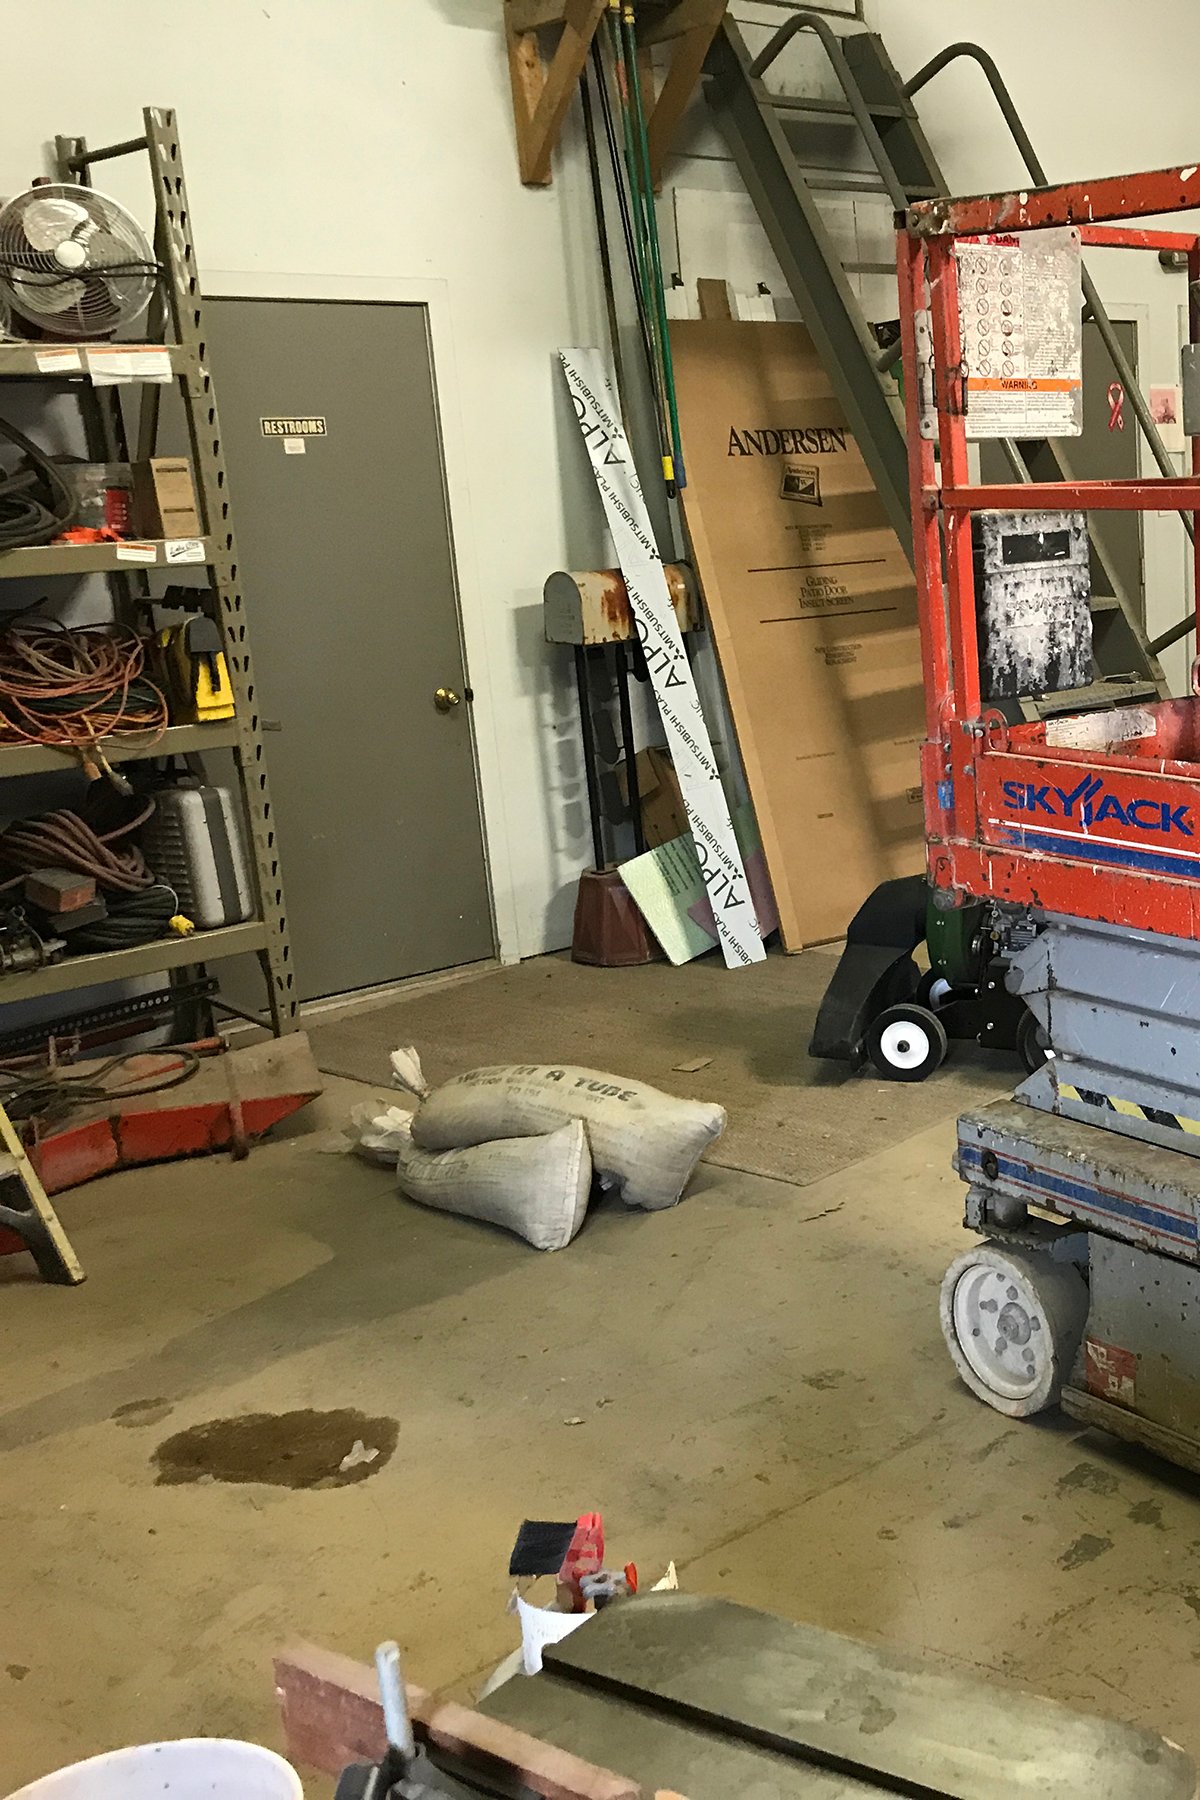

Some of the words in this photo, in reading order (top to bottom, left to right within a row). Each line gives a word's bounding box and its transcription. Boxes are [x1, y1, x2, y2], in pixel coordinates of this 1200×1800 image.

[568, 369, 613, 428] MITSUBISHI
[263, 420, 324, 434] RESTROOMS
[727, 425, 849, 457] ANDERSEN
[608, 492, 651, 549] MITSUBISHI
[798, 598, 825, 609] INSECT
[825, 596, 855, 606] SCREEN
[800, 587, 824, 598] PATIO
[825, 585, 848, 596] DOOR
[806, 575, 838, 587] GLIDING
[631, 592, 676, 649] MITSUBISHI
[669, 715, 712, 770] MITSUBISHI
[1003, 773, 1194, 836] SKYJACK
[691, 815, 734, 870] MITSUBISHI
[545, 1069, 567, 1082] A
[574, 1076, 638, 1102] TUBE
